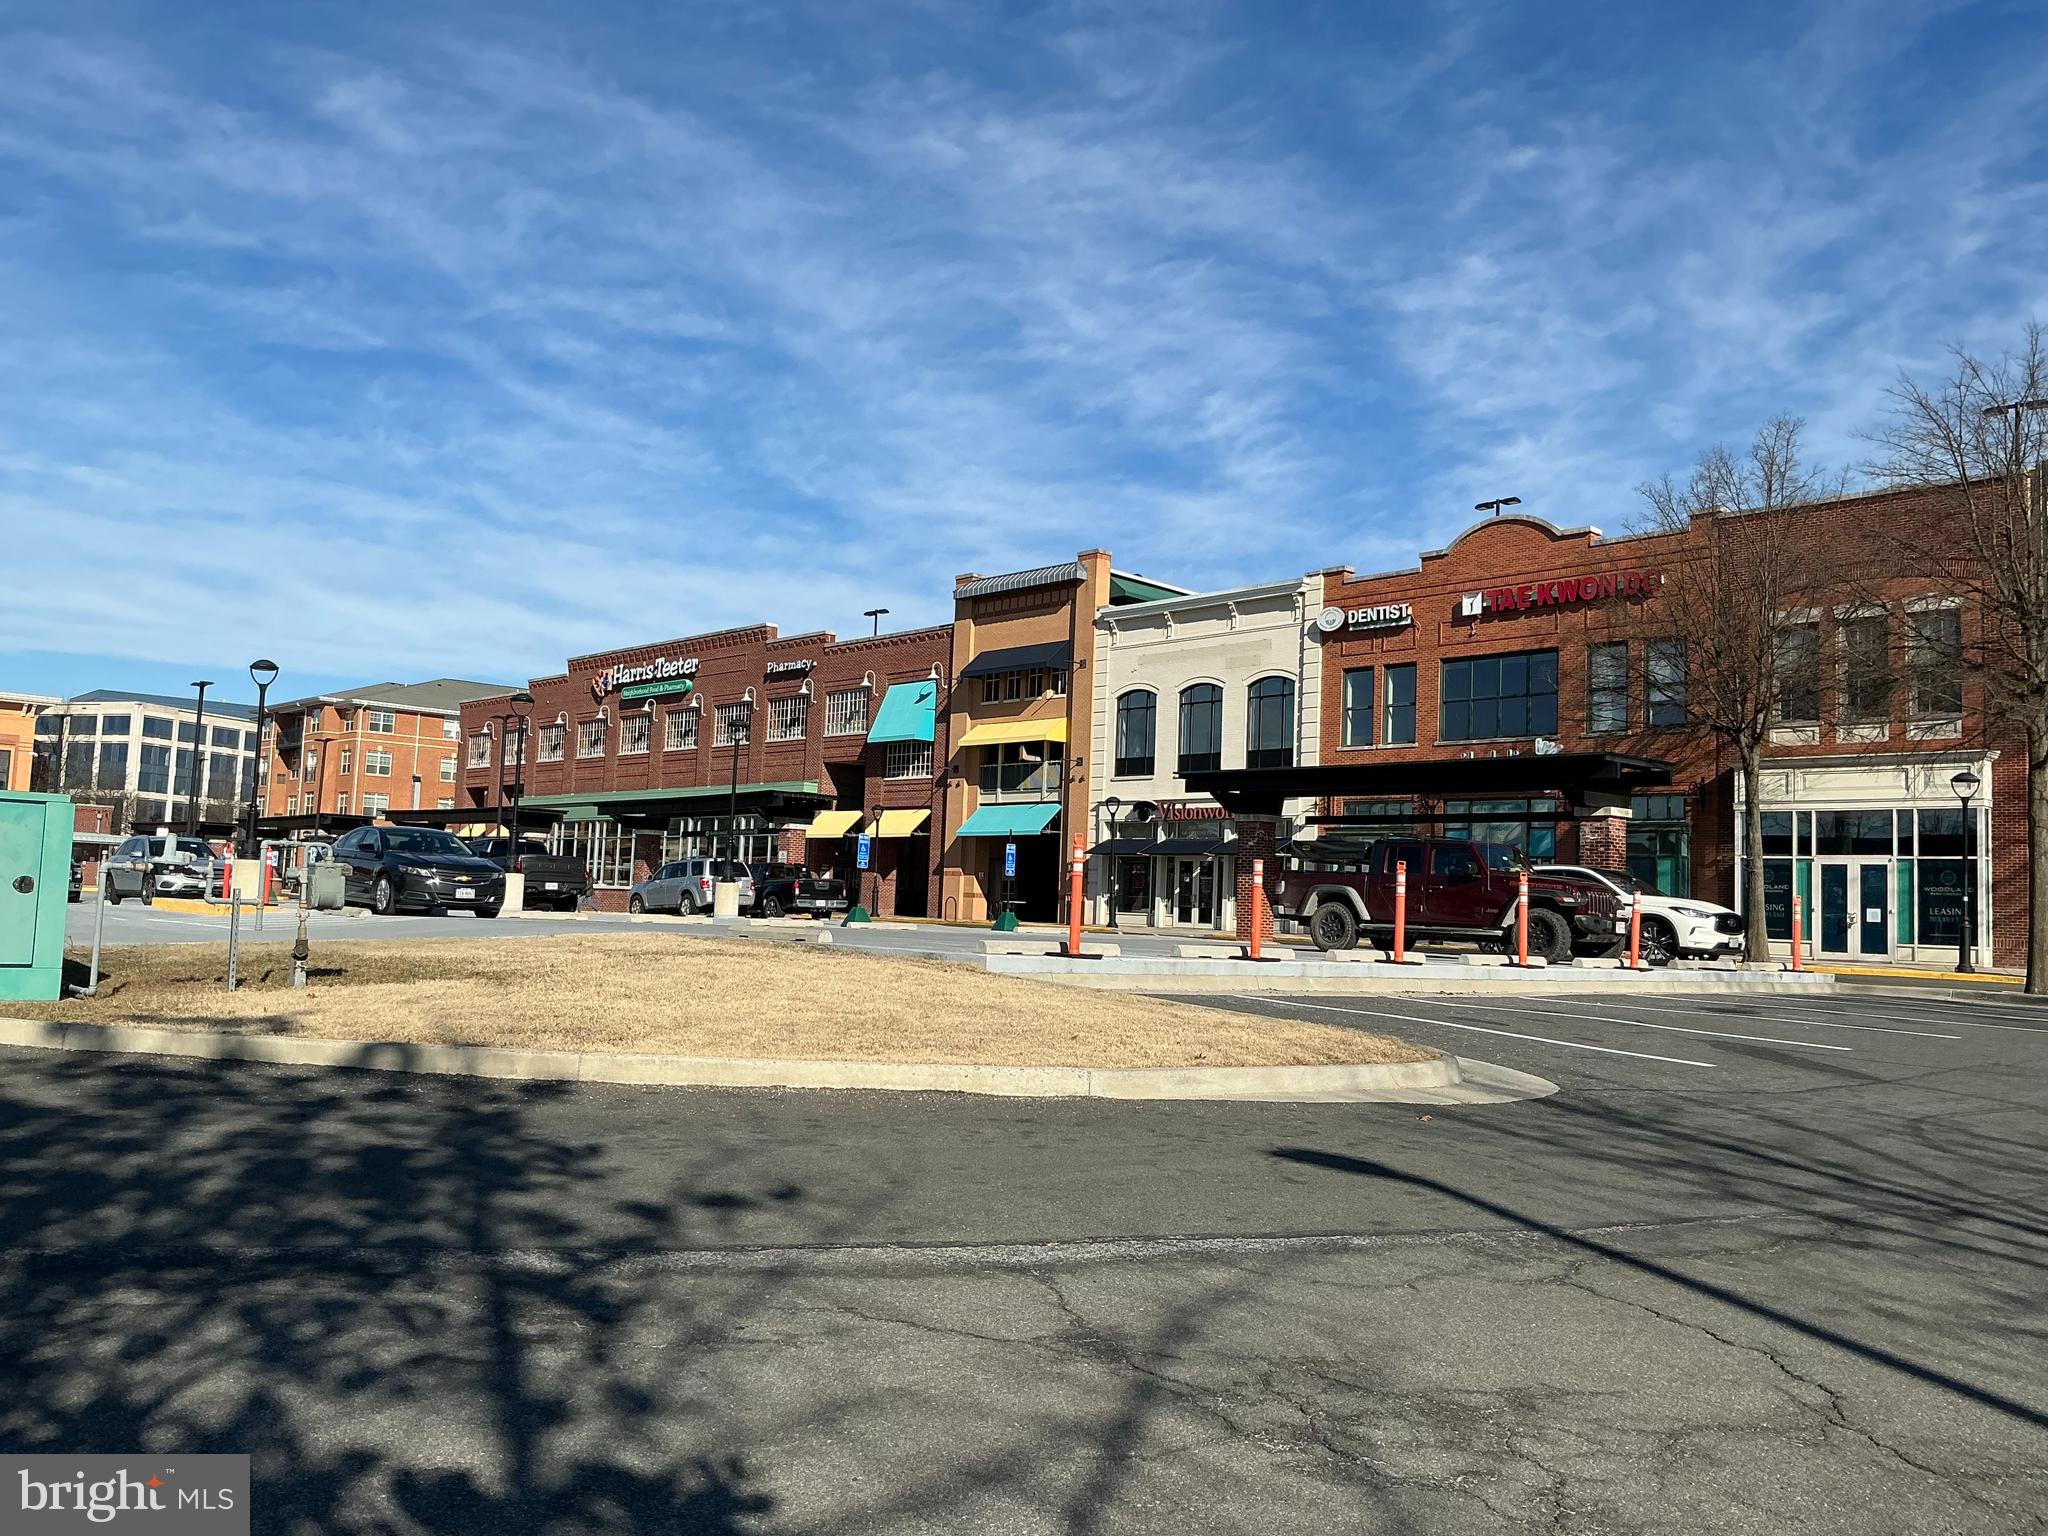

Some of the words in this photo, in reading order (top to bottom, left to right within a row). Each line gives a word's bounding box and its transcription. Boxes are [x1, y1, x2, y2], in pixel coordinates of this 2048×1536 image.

[1486, 585, 1532, 611] TAE
[1537, 574, 1618, 606] KWON
[1348, 603, 1410, 624] DENTIST
[613, 661, 654, 684] Harris
[655, 657, 699, 678] Teeter
[767, 659, 812, 673] Pharmacy
[1929, 907, 1962, 916] LEASIN
